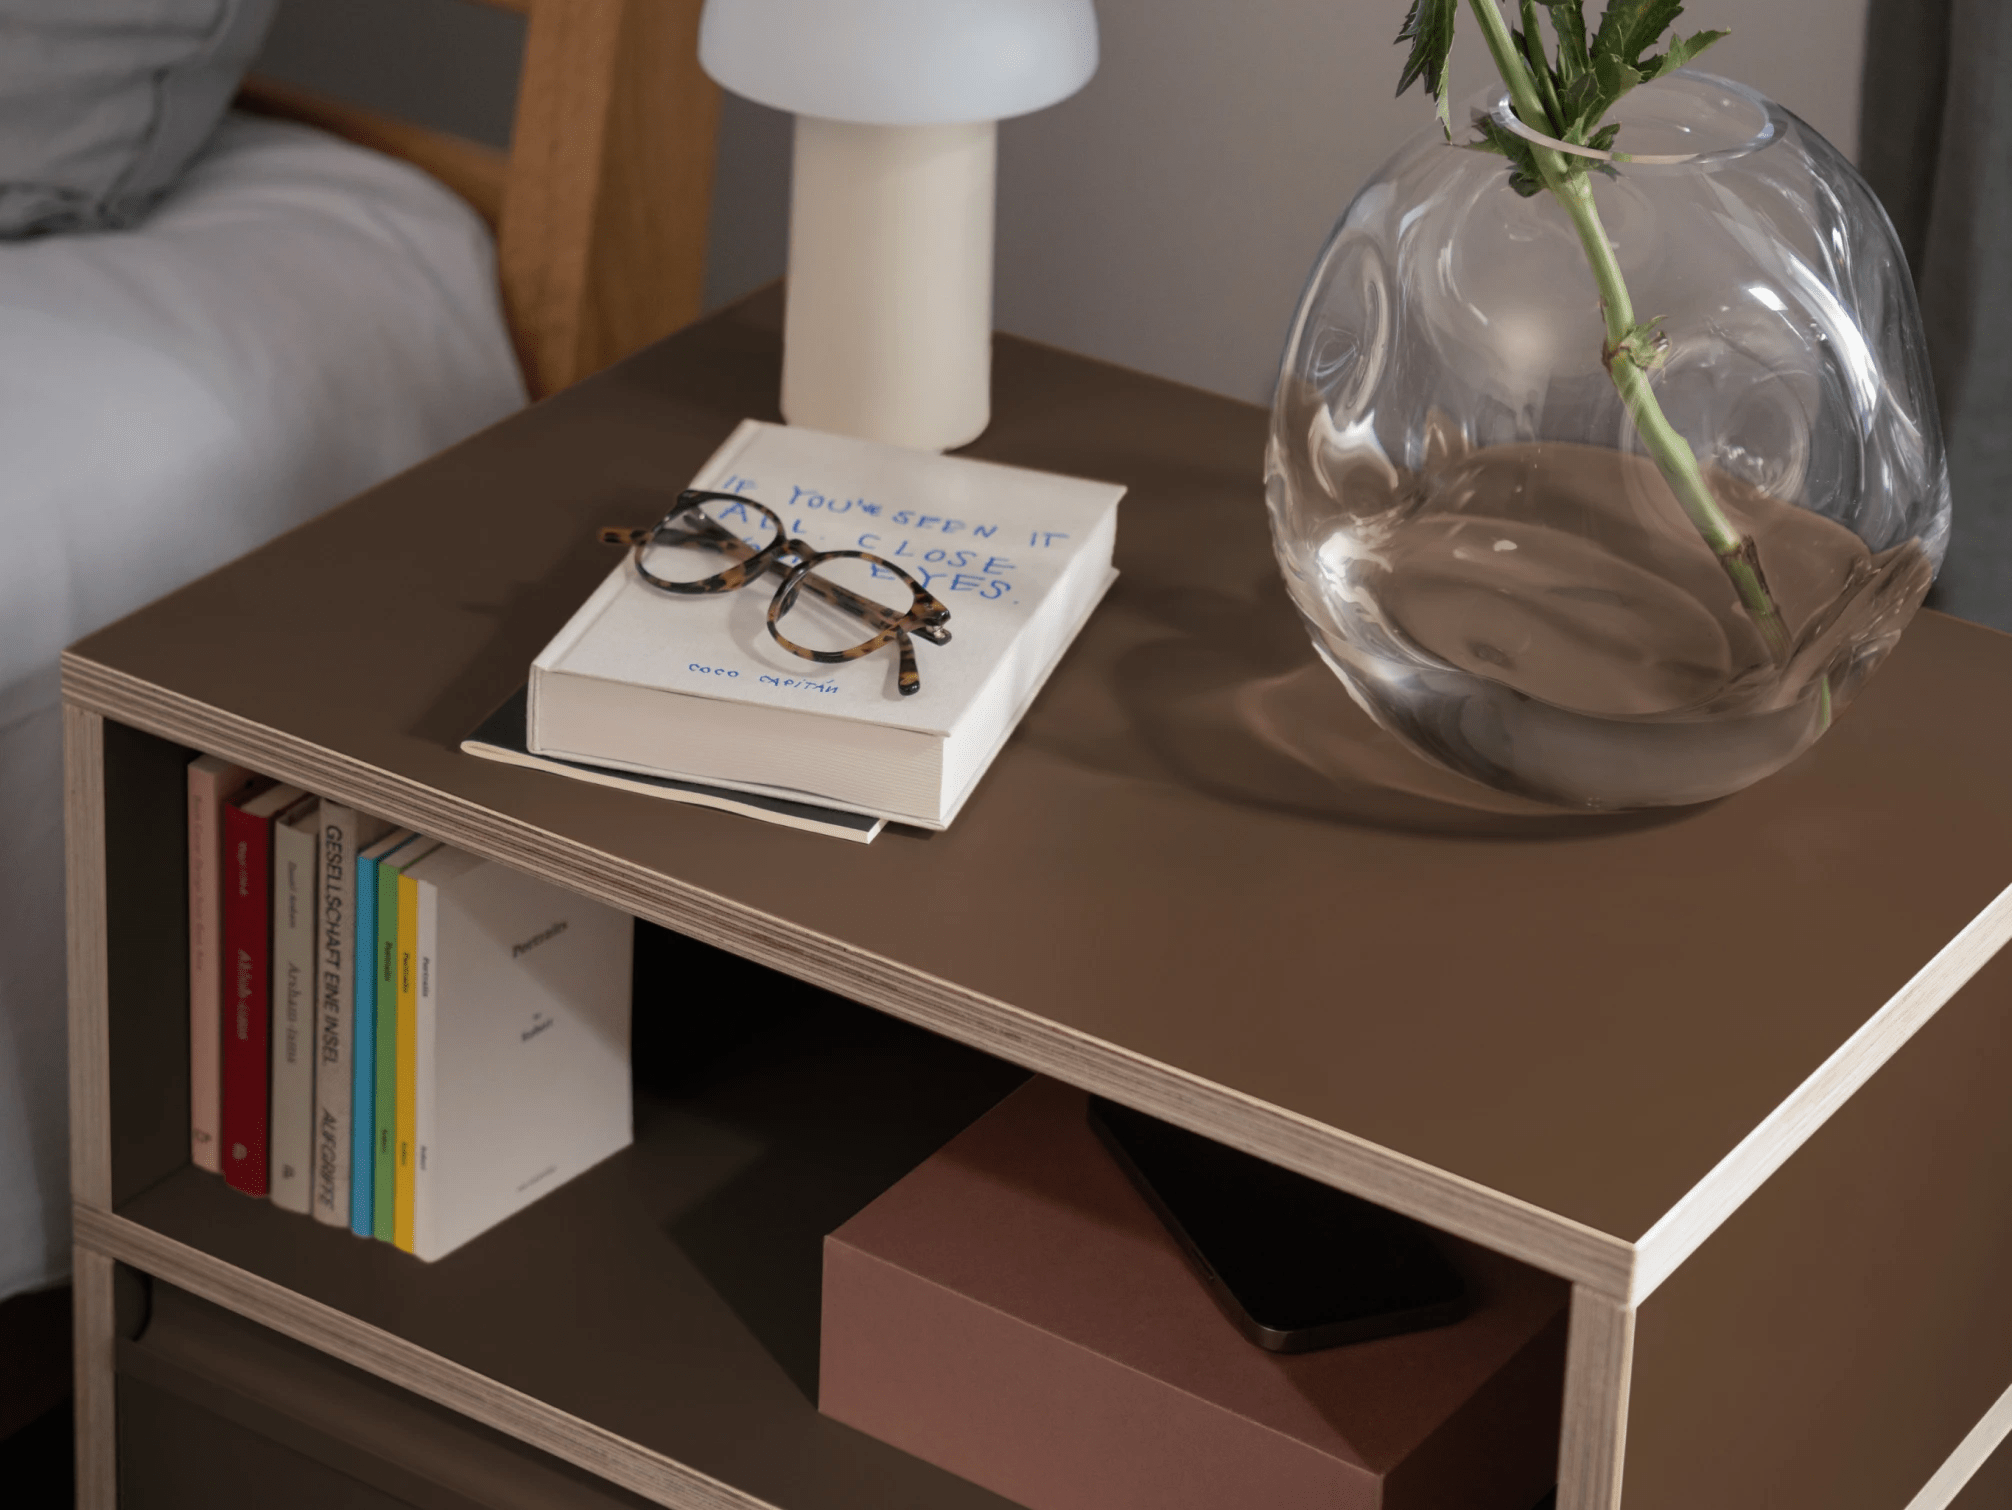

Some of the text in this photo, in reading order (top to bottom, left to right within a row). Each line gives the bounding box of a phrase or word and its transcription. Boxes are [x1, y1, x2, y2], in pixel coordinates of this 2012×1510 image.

[722, 474, 758, 495] IF
[891, 510, 998, 539] SEEN
[1029, 530, 1071, 548] IT
[857, 532, 1018, 576] CLOSE
[687, 662, 740, 679] COCO
[321, 824, 343, 1067] GESELLSCHAFT EINE INSEL
[320, 1106, 338, 1212] AUFGRIFFE
